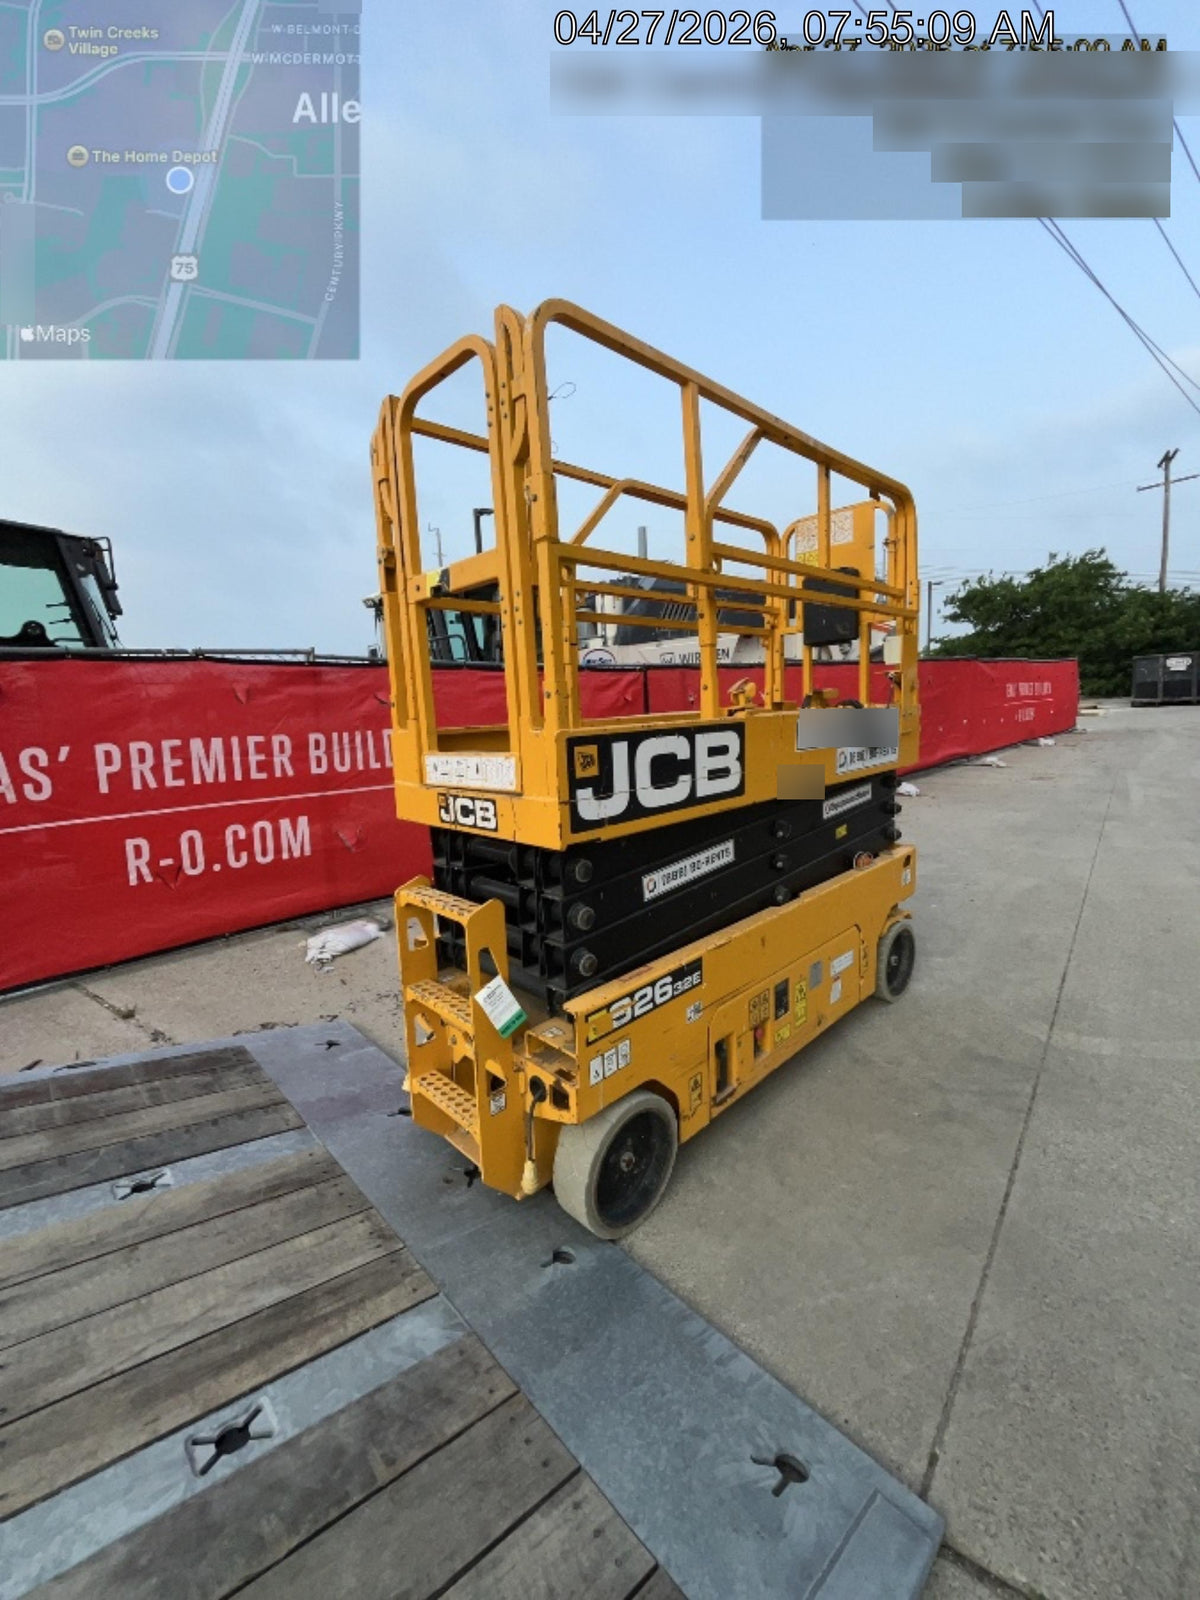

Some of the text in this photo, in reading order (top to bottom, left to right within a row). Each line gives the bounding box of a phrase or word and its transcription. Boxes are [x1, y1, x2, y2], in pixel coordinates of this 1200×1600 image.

[94, 734, 294, 794] PREMIER
[575, 729, 743, 822] JCB
[440, 795, 498, 830] JCB
[125, 815, 311, 887] R-O.COM
